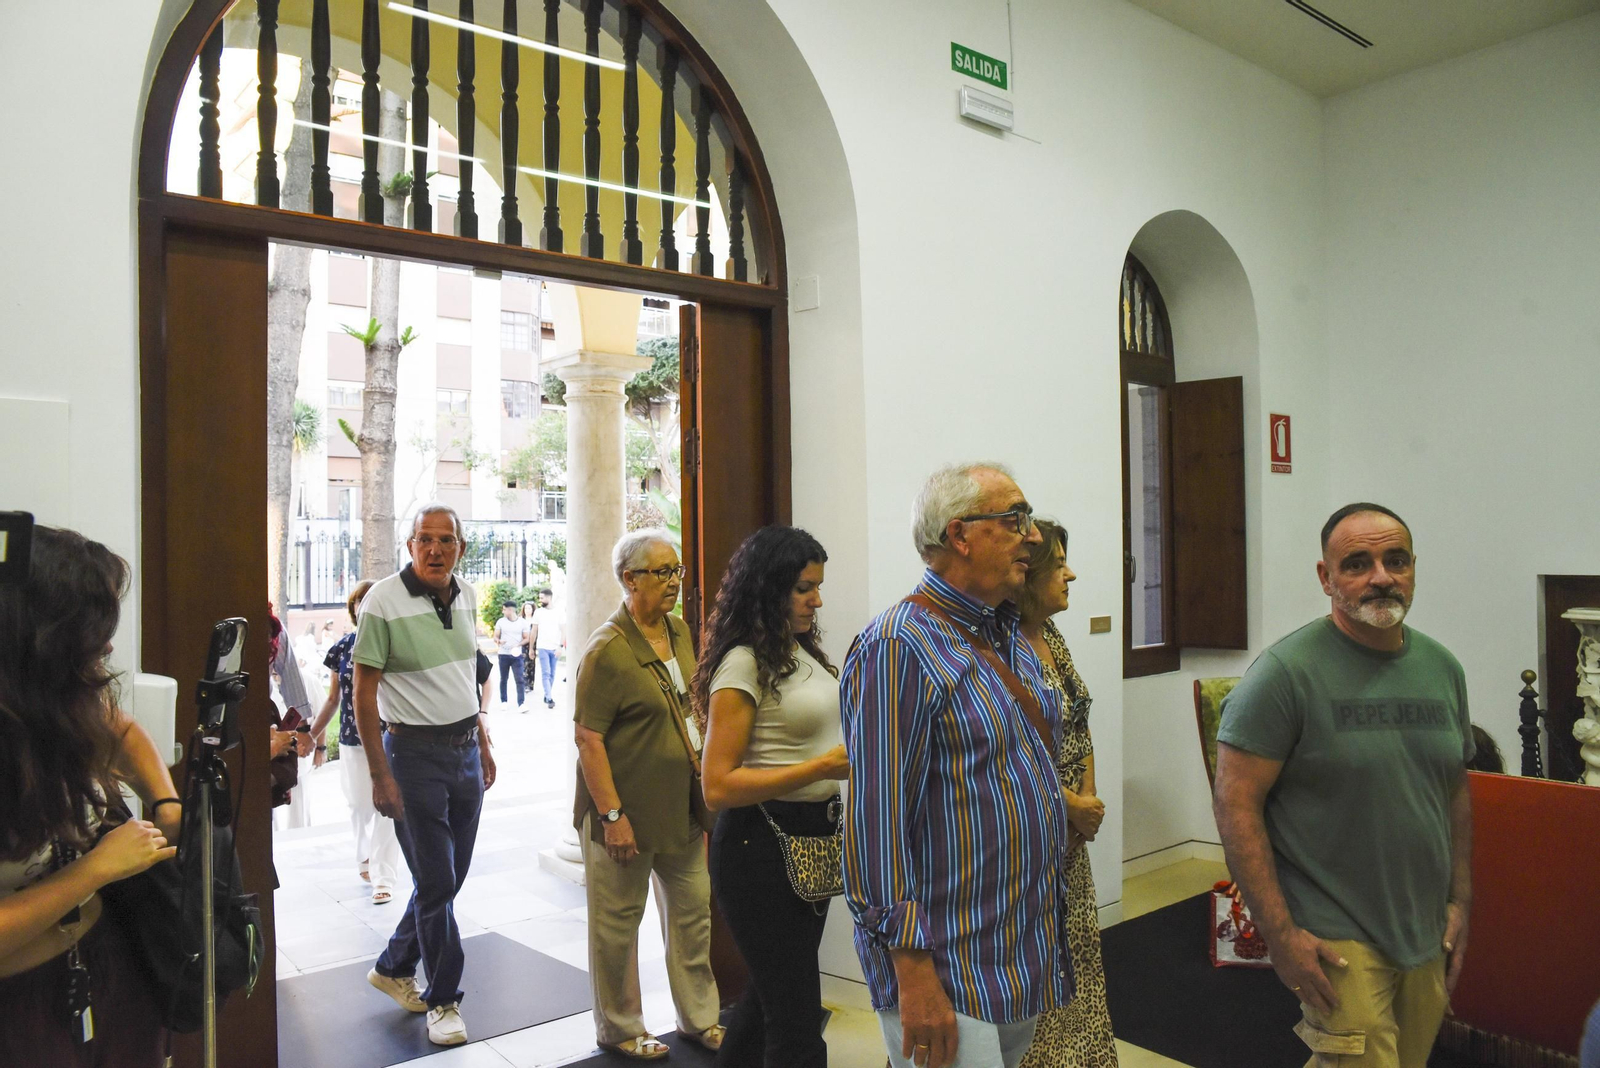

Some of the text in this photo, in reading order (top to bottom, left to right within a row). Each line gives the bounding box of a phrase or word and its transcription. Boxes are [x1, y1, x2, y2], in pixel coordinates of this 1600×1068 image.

[955, 49, 1002, 83] SALIDA
[1340, 703, 1447, 726] PEPE JEANS
